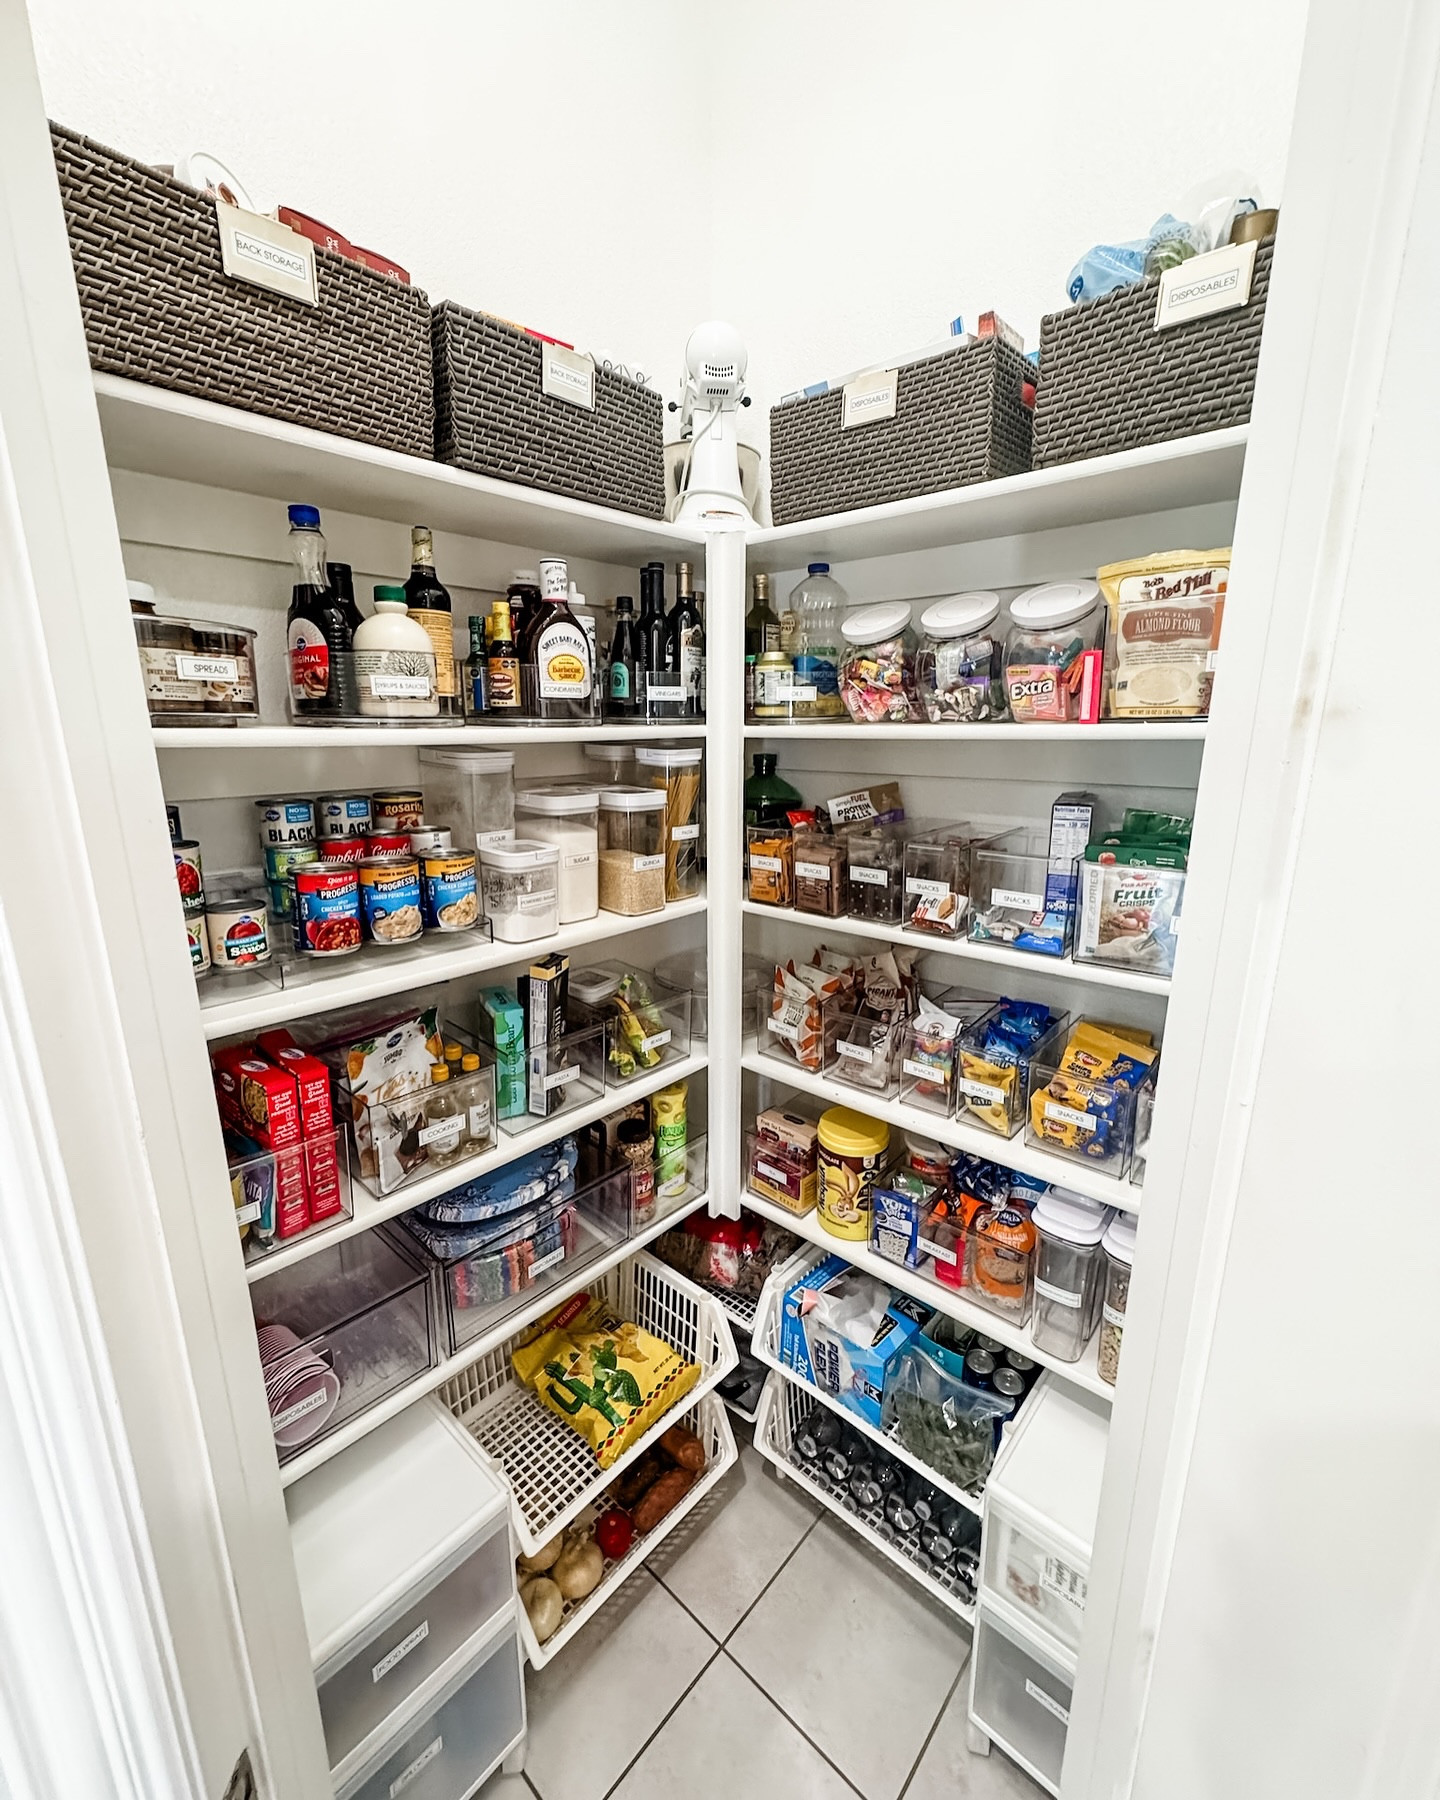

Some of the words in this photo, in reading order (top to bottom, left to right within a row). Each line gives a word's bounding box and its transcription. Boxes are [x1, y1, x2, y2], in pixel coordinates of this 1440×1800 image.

[237, 239, 262, 257] BACK
[264, 250, 304, 274] STORAGE
[1170, 276, 1236, 302] DISPOSABLES
[551, 366, 565, 379] BACK
[566, 373, 588, 387] STORAGE
[851, 392, 889, 408] DISPOSABLES
[1155, 581, 1181, 600] Red
[1184, 571, 1212, 596] Mill
[1136, 618, 1170, 634] ALMOND
[1172, 617, 1201, 632] FLOUR
[542, 636, 558, 652] SWEET
[560, 636, 572, 644] BABY
[194, 664, 228, 674] SPREADS
[1010, 680, 1054, 700] Extra
[838, 804, 871, 817] PROTEIN
[844, 811, 871, 822] BALLS
[269, 826, 314, 842] BLACK
[330, 821, 371, 835] BLACK
[378, 876, 415, 892] PROGRESSO
[916, 884, 940, 892] SNACKS
[1004, 896, 1031, 905] SNACKS
[1113, 887, 1163, 903] Fruit
[321, 904, 342, 913] CHICKEN
[230, 942, 265, 957] Sauce
[775, 1025, 791, 1033] SNACKS
[846, 1047, 864, 1057] SNACKS
[913, 1066, 935, 1077] SNACKS
[1071, 1062, 1092, 1074] CHIPS
[970, 1085, 994, 1097] SNACKS
[1057, 1110, 1084, 1122] SNACKS
[427, 1122, 459, 1138] COOKING
[923, 1243, 952, 1259] BREAKFAST
[814, 1338, 827, 1386] FLEX
[826, 1340, 840, 1393] POWER
[274, 1394, 323, 1426] DISPOSABLES
[1043, 1579, 1086, 1611] DISPOSABL
